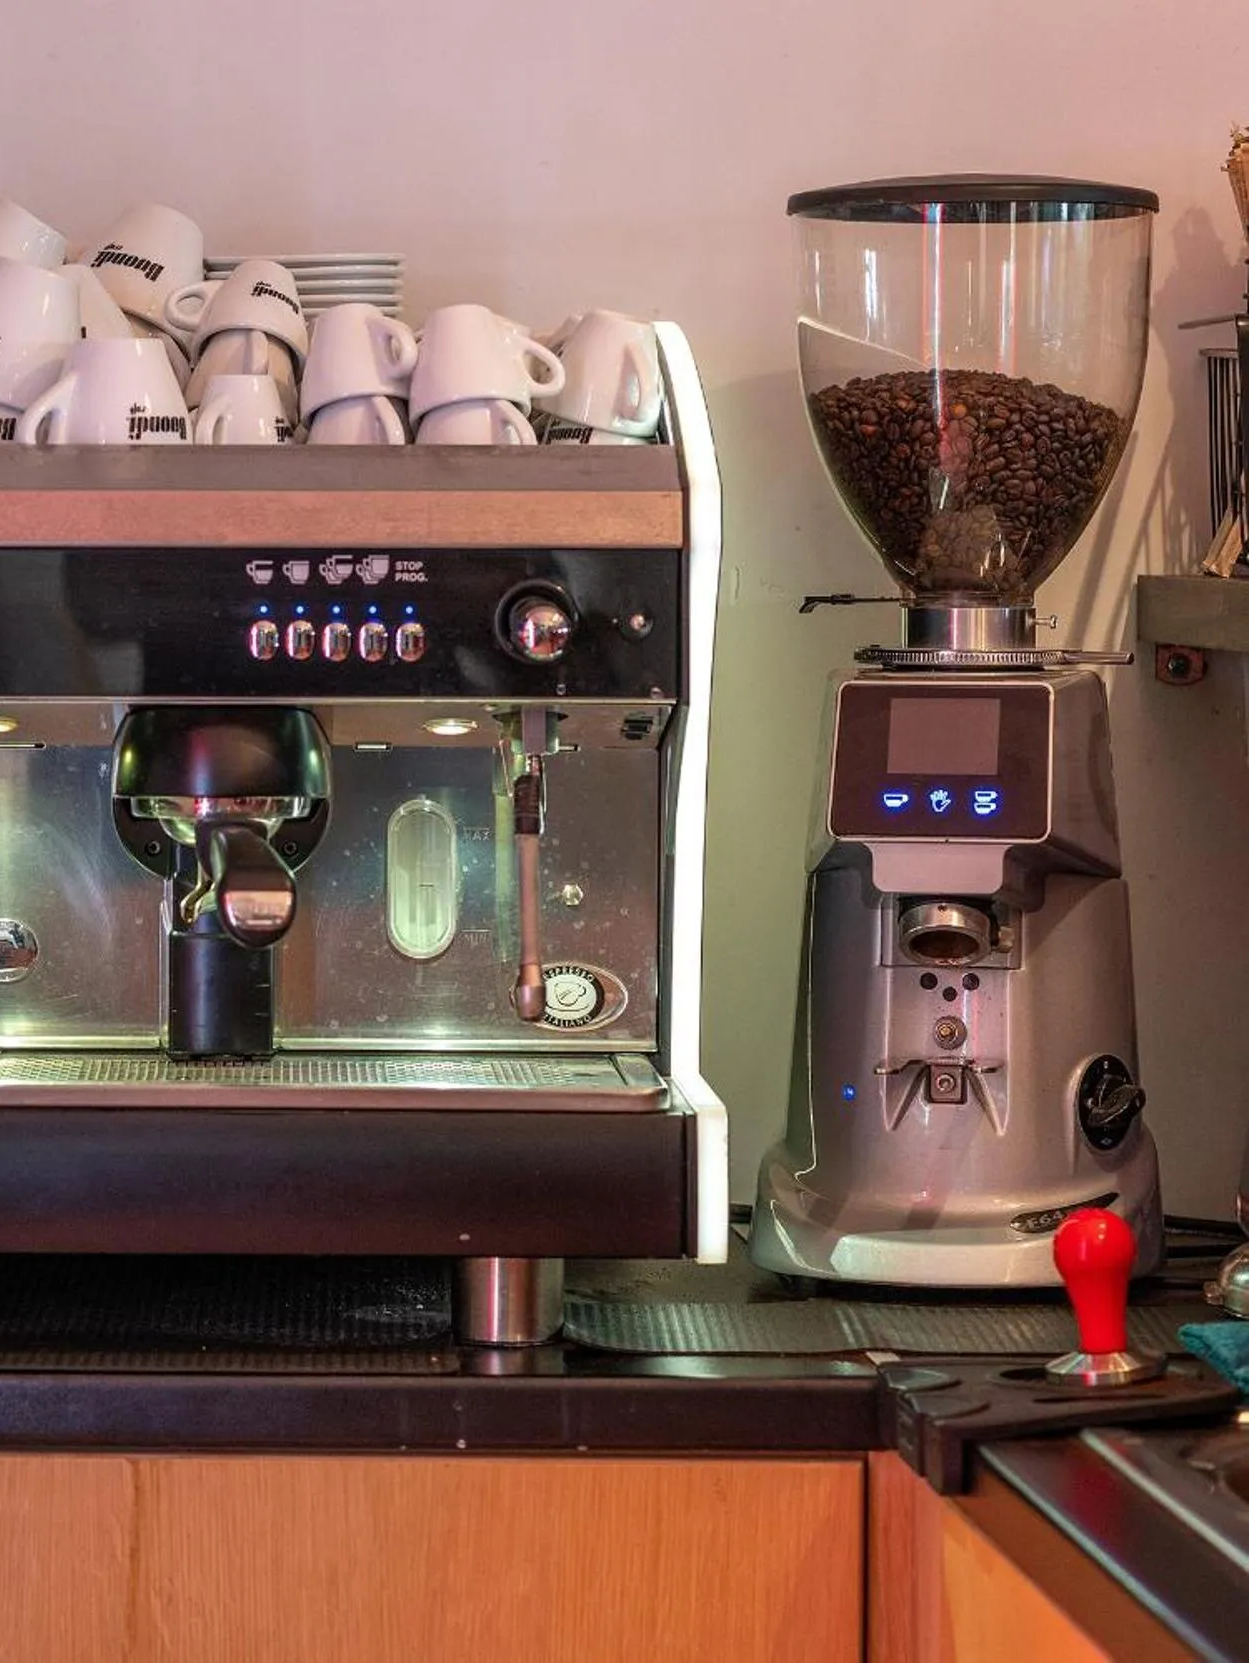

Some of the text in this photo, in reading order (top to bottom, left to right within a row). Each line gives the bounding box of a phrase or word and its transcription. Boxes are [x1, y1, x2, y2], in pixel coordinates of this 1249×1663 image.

[90, 250, 165, 282] Buondi
[128, 415, 187, 440] Buondi
[395, 561, 423, 570] STOP
